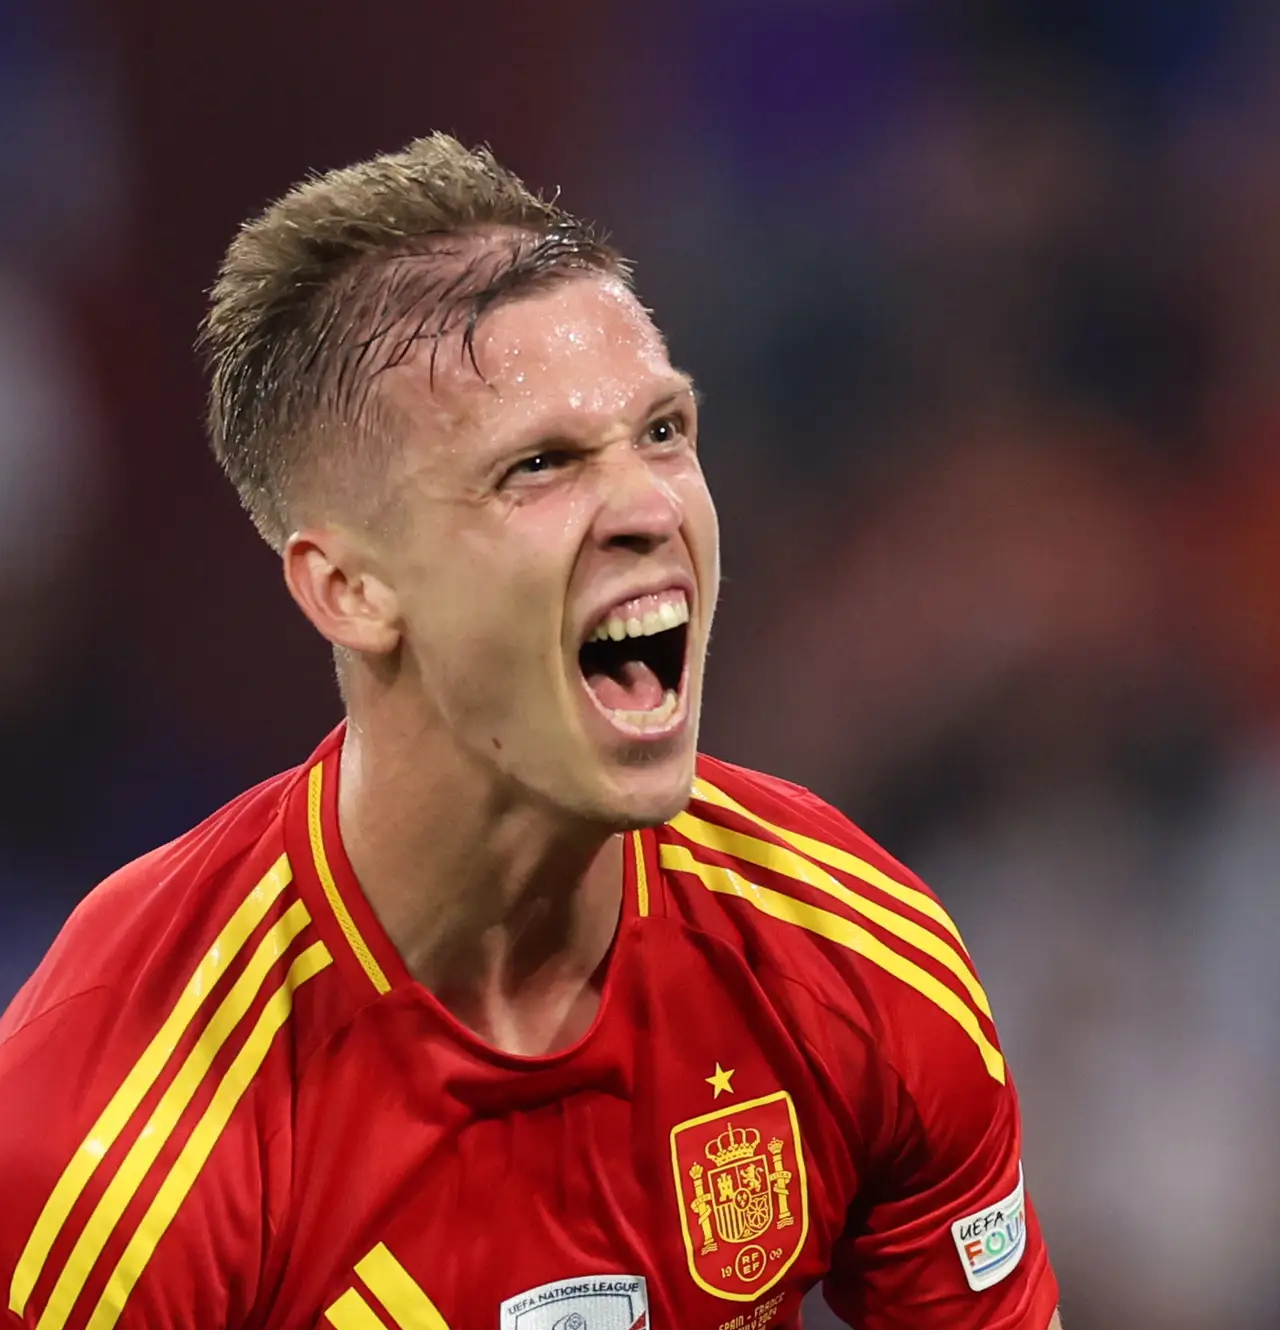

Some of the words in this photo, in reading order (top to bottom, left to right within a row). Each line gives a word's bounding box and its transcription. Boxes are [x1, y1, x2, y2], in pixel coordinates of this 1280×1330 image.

[960, 1211, 1004, 1240] UEFA
[964, 1211, 1024, 1266] FOU
[721, 1266, 733, 1278] 19
[508, 1298, 536, 1315] UEFA
[538, 1283, 590, 1303] NATIONS
[592, 1282, 639, 1293] LEAGUE
